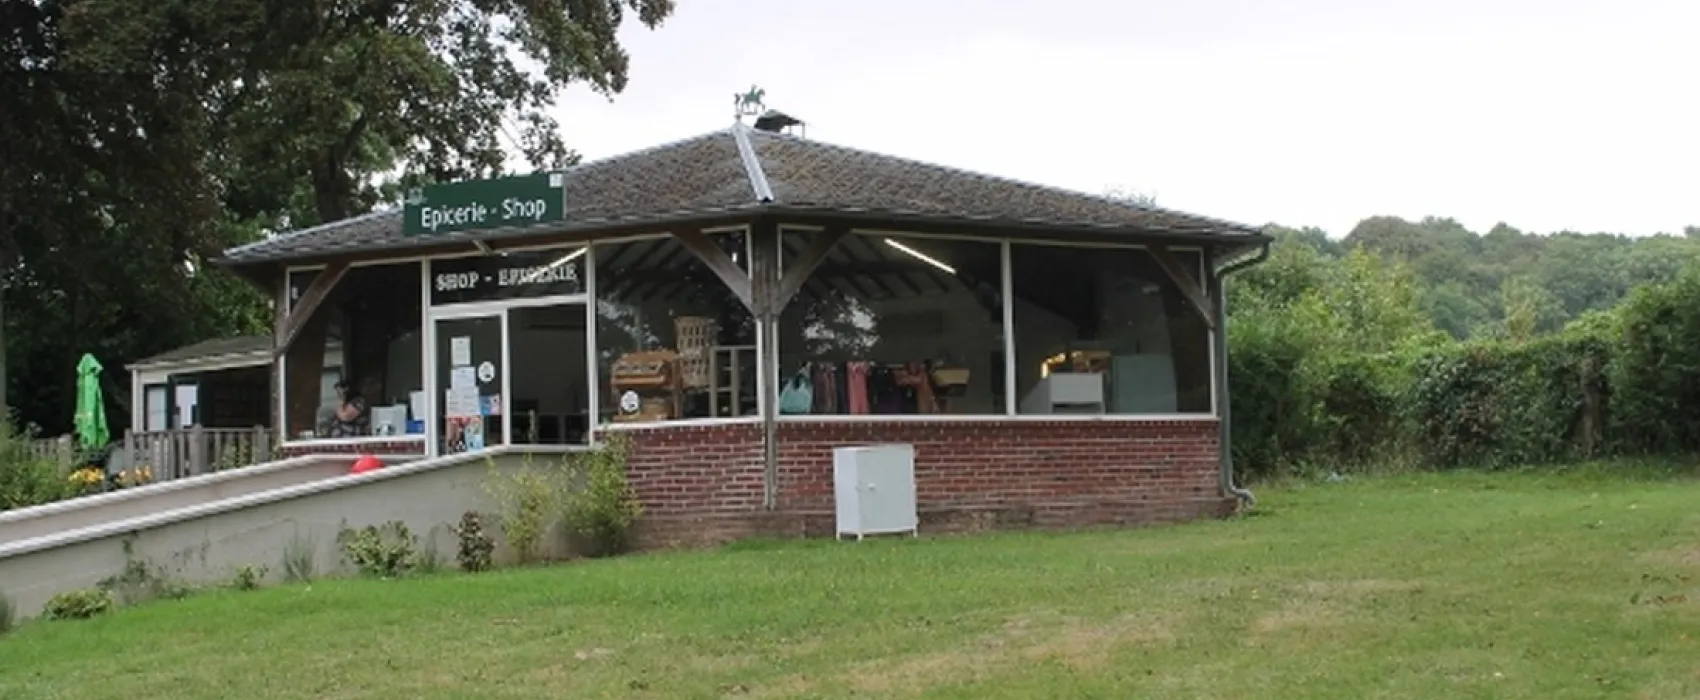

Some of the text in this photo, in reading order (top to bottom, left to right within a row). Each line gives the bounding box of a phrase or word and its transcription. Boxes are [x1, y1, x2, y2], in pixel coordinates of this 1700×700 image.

[421, 202, 487, 231] Epicerie
[502, 198, 546, 221] Shop
[436, 271, 479, 291] SHOP
